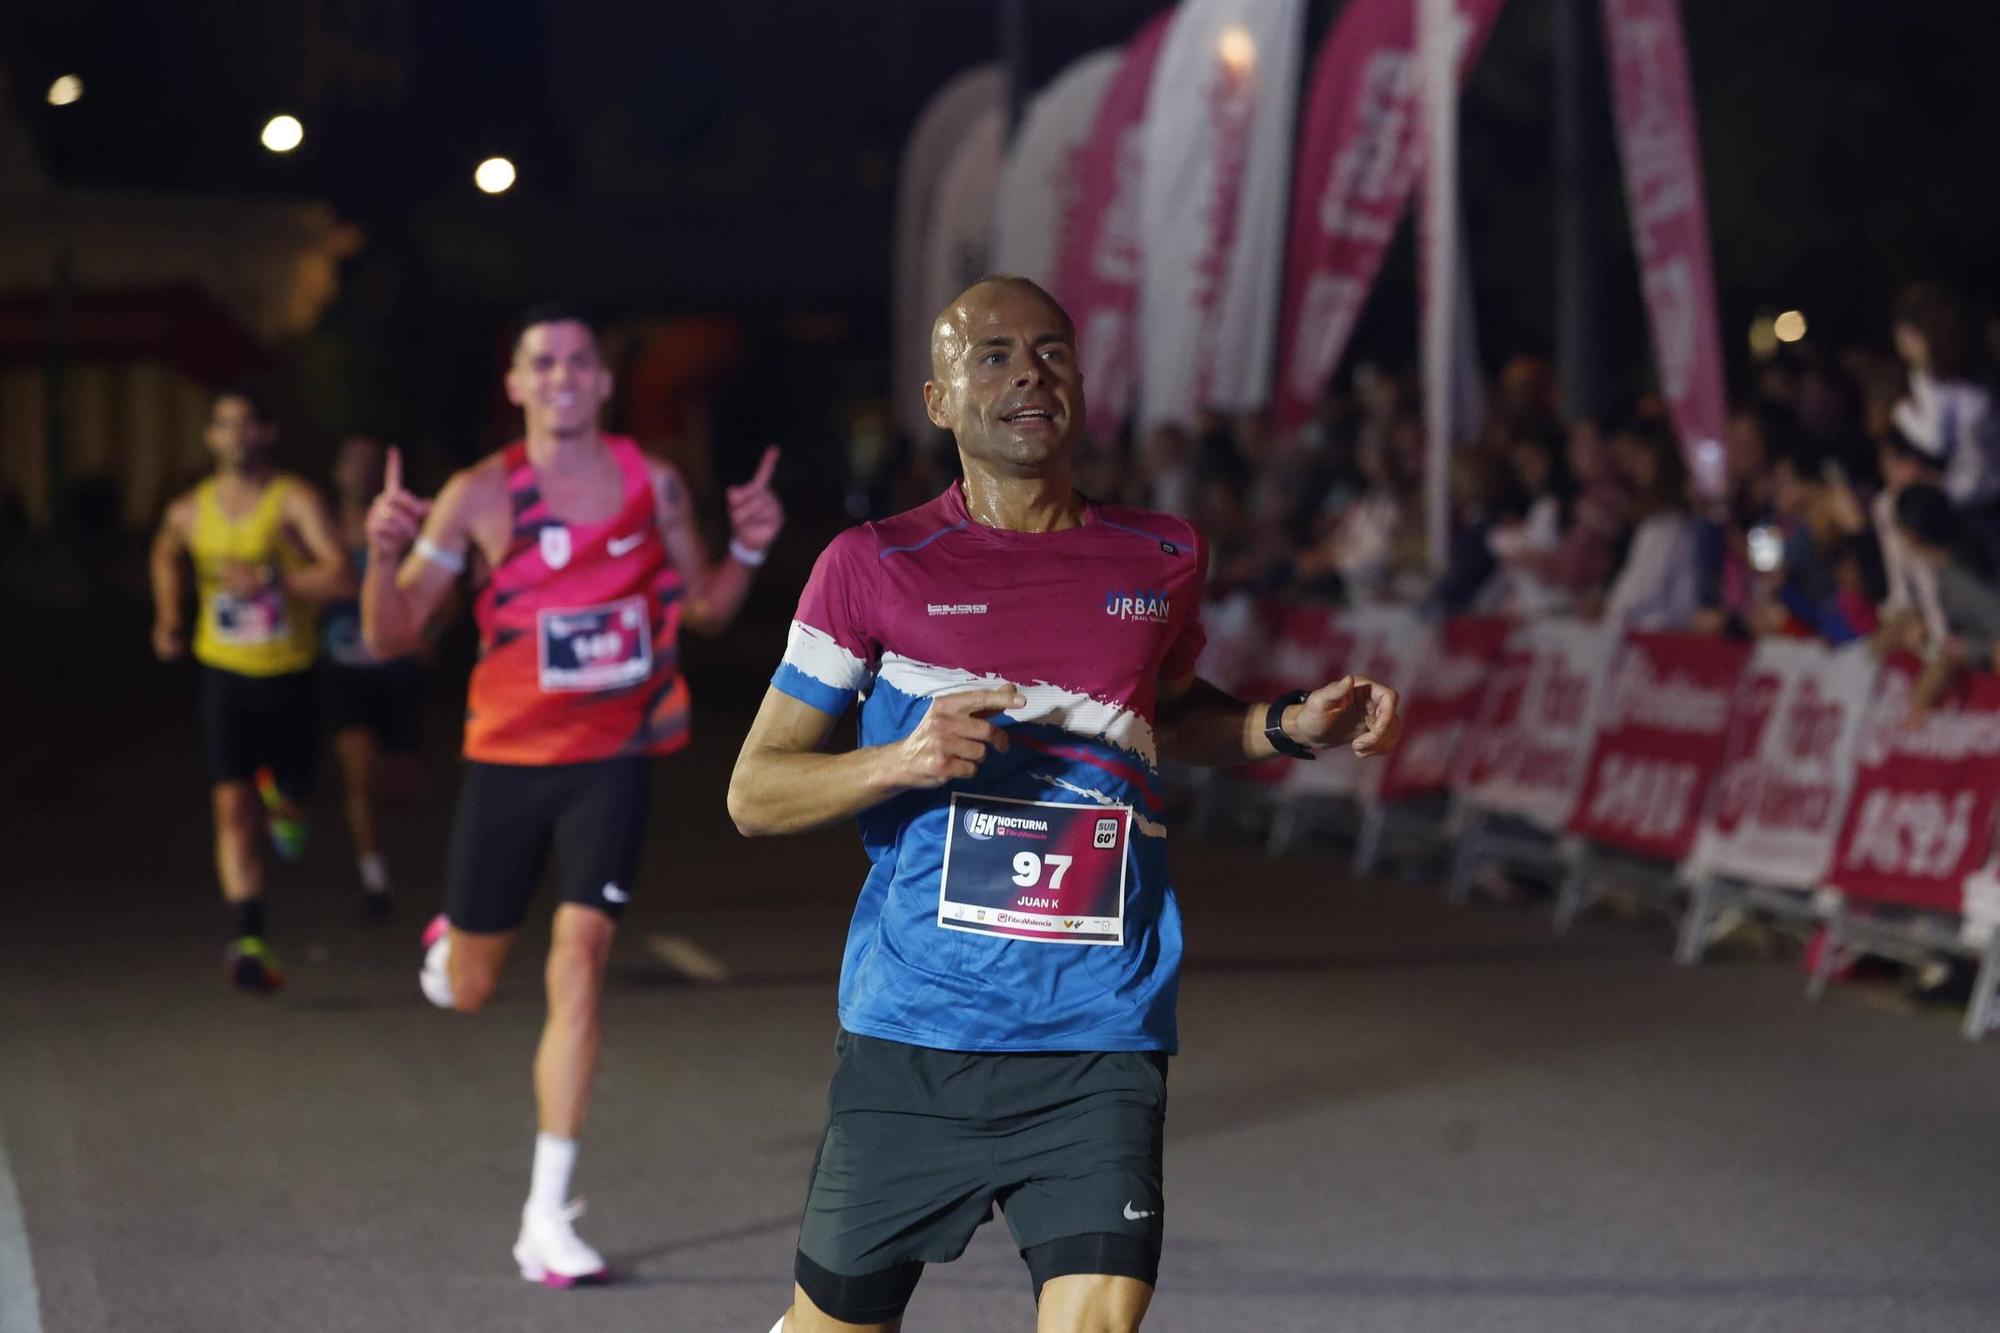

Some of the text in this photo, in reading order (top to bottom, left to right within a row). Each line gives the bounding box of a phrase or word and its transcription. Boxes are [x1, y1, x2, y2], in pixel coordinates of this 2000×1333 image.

[969, 812, 1048, 836] 15K NOCTURNA
[1098, 822, 1116, 831] SUB
[1011, 851, 1073, 889] 97
[1017, 896, 1060, 909] JUAN K
[1007, 915, 1052, 928] FibraValencia
